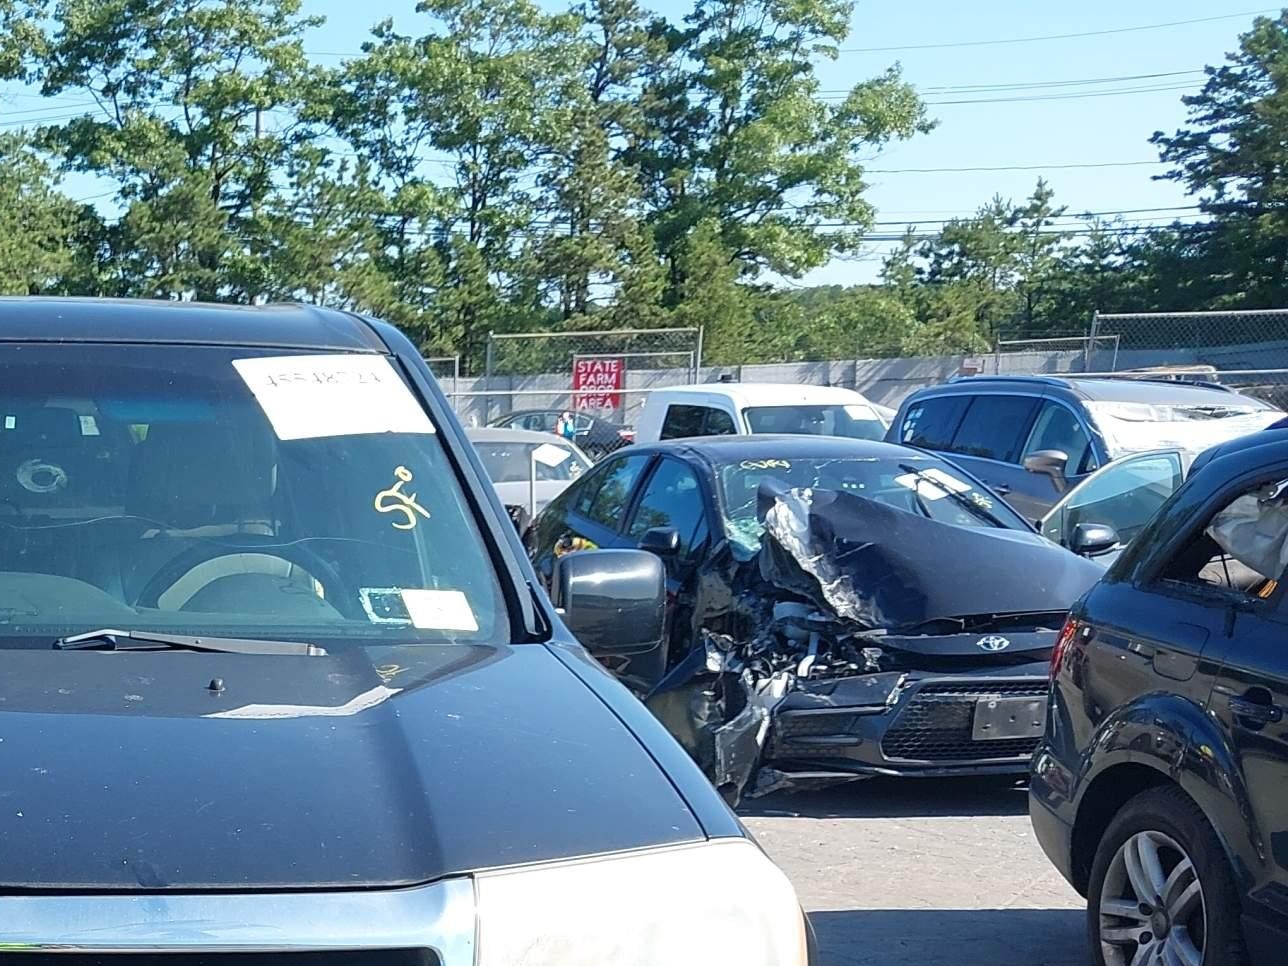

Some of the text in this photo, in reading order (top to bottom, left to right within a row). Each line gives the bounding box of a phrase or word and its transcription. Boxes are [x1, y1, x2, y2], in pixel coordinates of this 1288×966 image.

[577, 360, 618, 372] STATE
[579, 373, 617, 385] FARM
[579, 398, 613, 410] AREA
